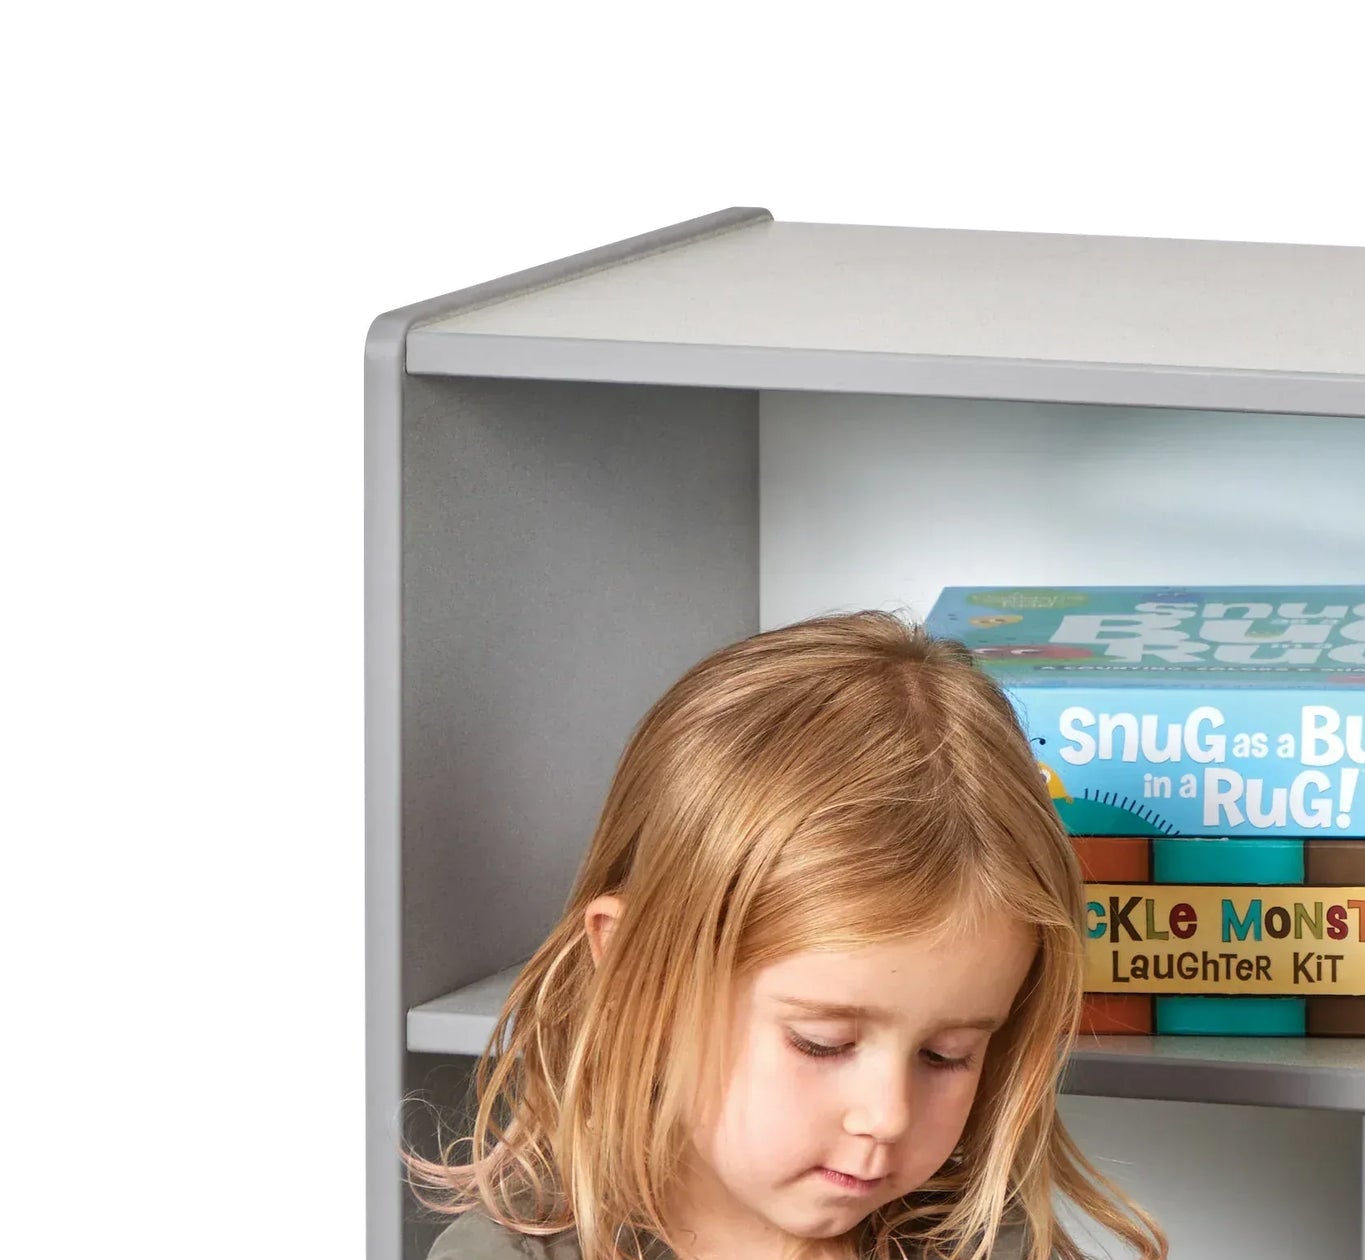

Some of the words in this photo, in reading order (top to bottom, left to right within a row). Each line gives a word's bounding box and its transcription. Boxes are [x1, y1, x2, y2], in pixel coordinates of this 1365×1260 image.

[1232, 732, 1270, 759] as
[1276, 733, 1296, 759] a
[1143, 772, 1171, 799] in
[1179, 773, 1197, 799] a
